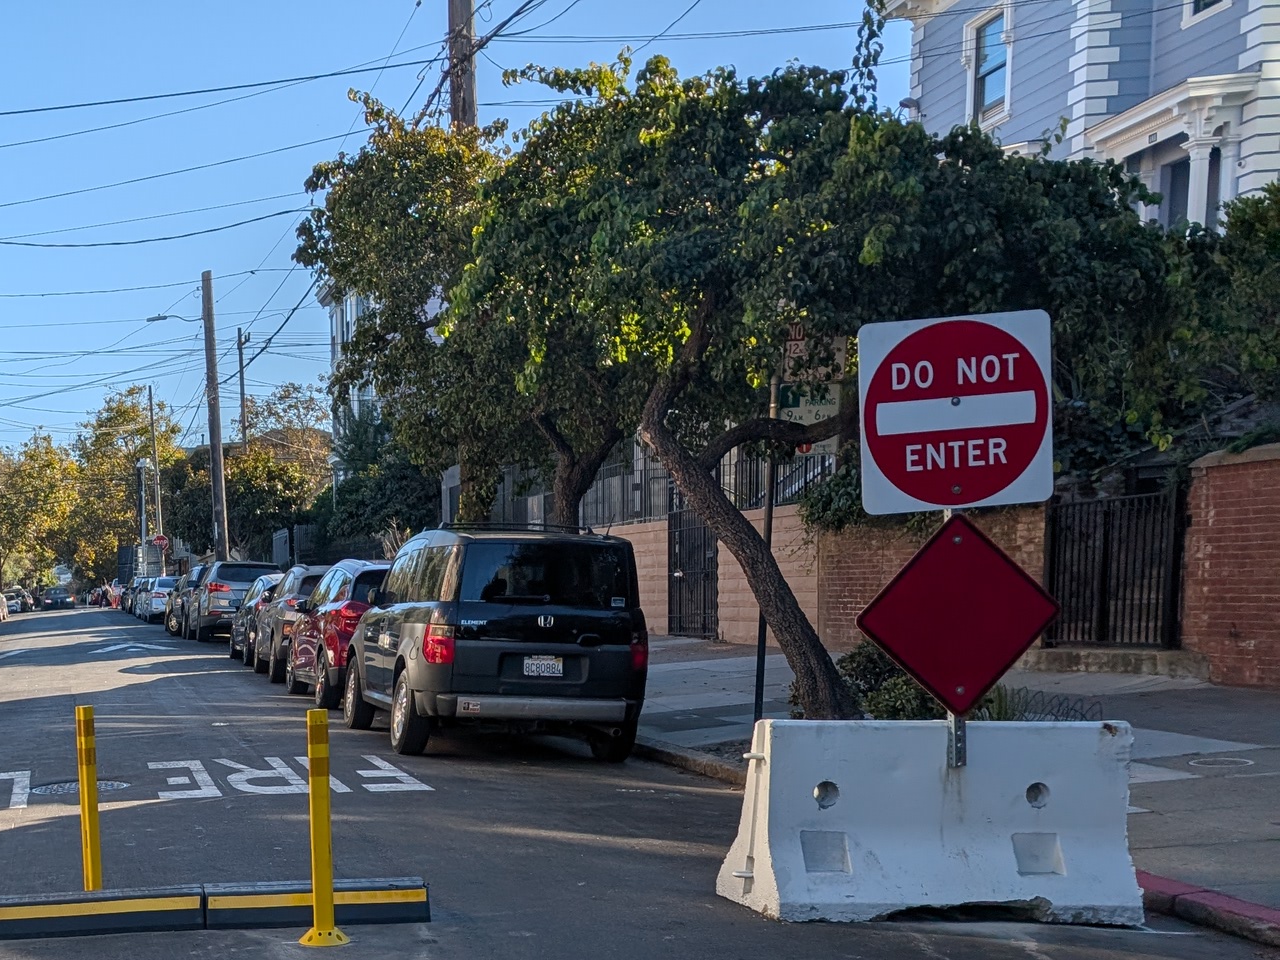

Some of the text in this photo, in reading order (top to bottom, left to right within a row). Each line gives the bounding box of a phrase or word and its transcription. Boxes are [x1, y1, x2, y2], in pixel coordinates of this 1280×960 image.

[788, 325, 804, 340] NO
[789, 343, 800, 355] 12
[891, 352, 1020, 391] DO NOT
[805, 398, 836, 407] PARKING
[786, 410, 794, 421] 9
[814, 409, 821, 421] 6
[905, 437, 1008, 472] ENTER
[525, 662, 561, 674] 8C80884
[147, 754, 436, 800] FIRE
